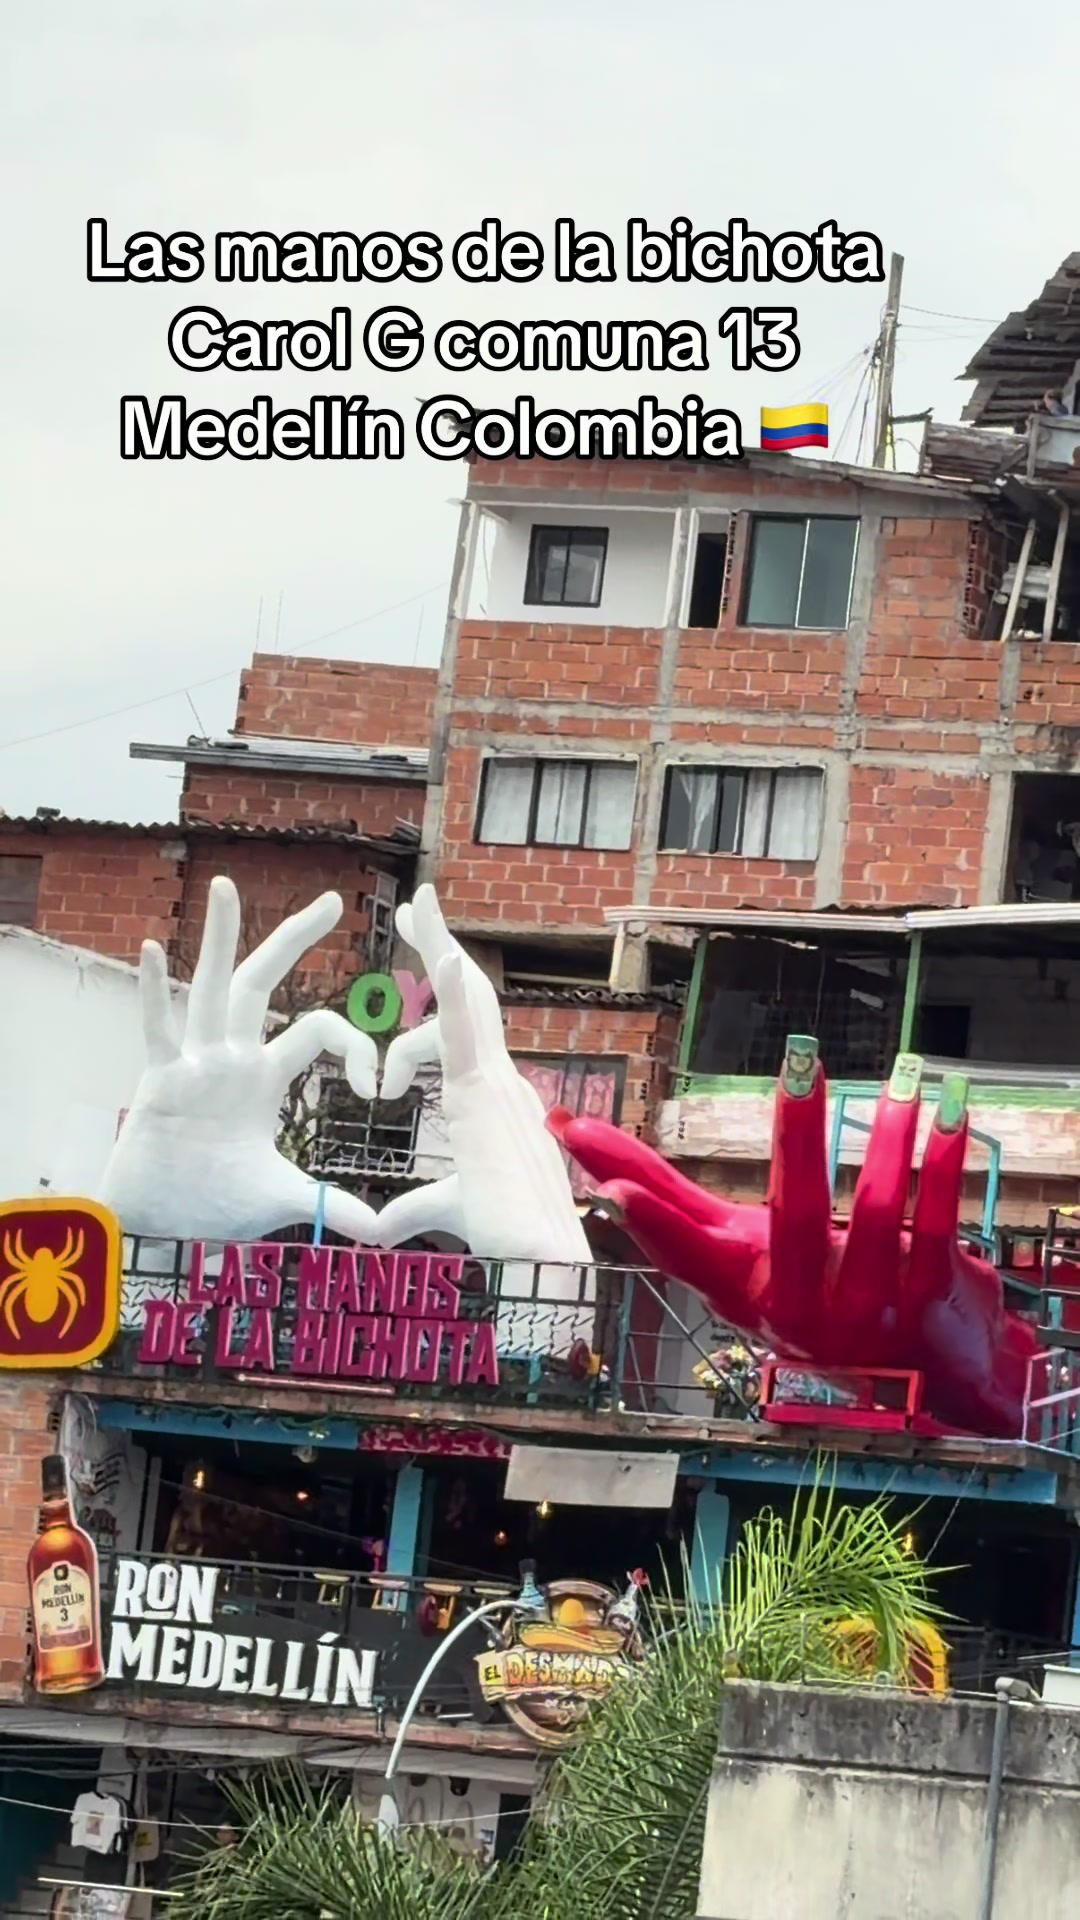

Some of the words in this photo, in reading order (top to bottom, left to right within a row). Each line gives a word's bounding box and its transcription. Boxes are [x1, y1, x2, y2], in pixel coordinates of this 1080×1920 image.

[187, 1242, 283, 1307] LAS
[299, 1246, 465, 1319] MANOS
[138, 1300, 212, 1364] DE
[215, 1304, 275, 1371] LA
[292, 1311, 499, 1385] BICHOTA
[53, 1583, 71, 1595] RON
[60, 1608, 68, 1621] 3
[111, 1559, 220, 1624] RON
[105, 1621, 378, 1708] MEDELLÍN
[484, 1665, 501, 1681] EL
